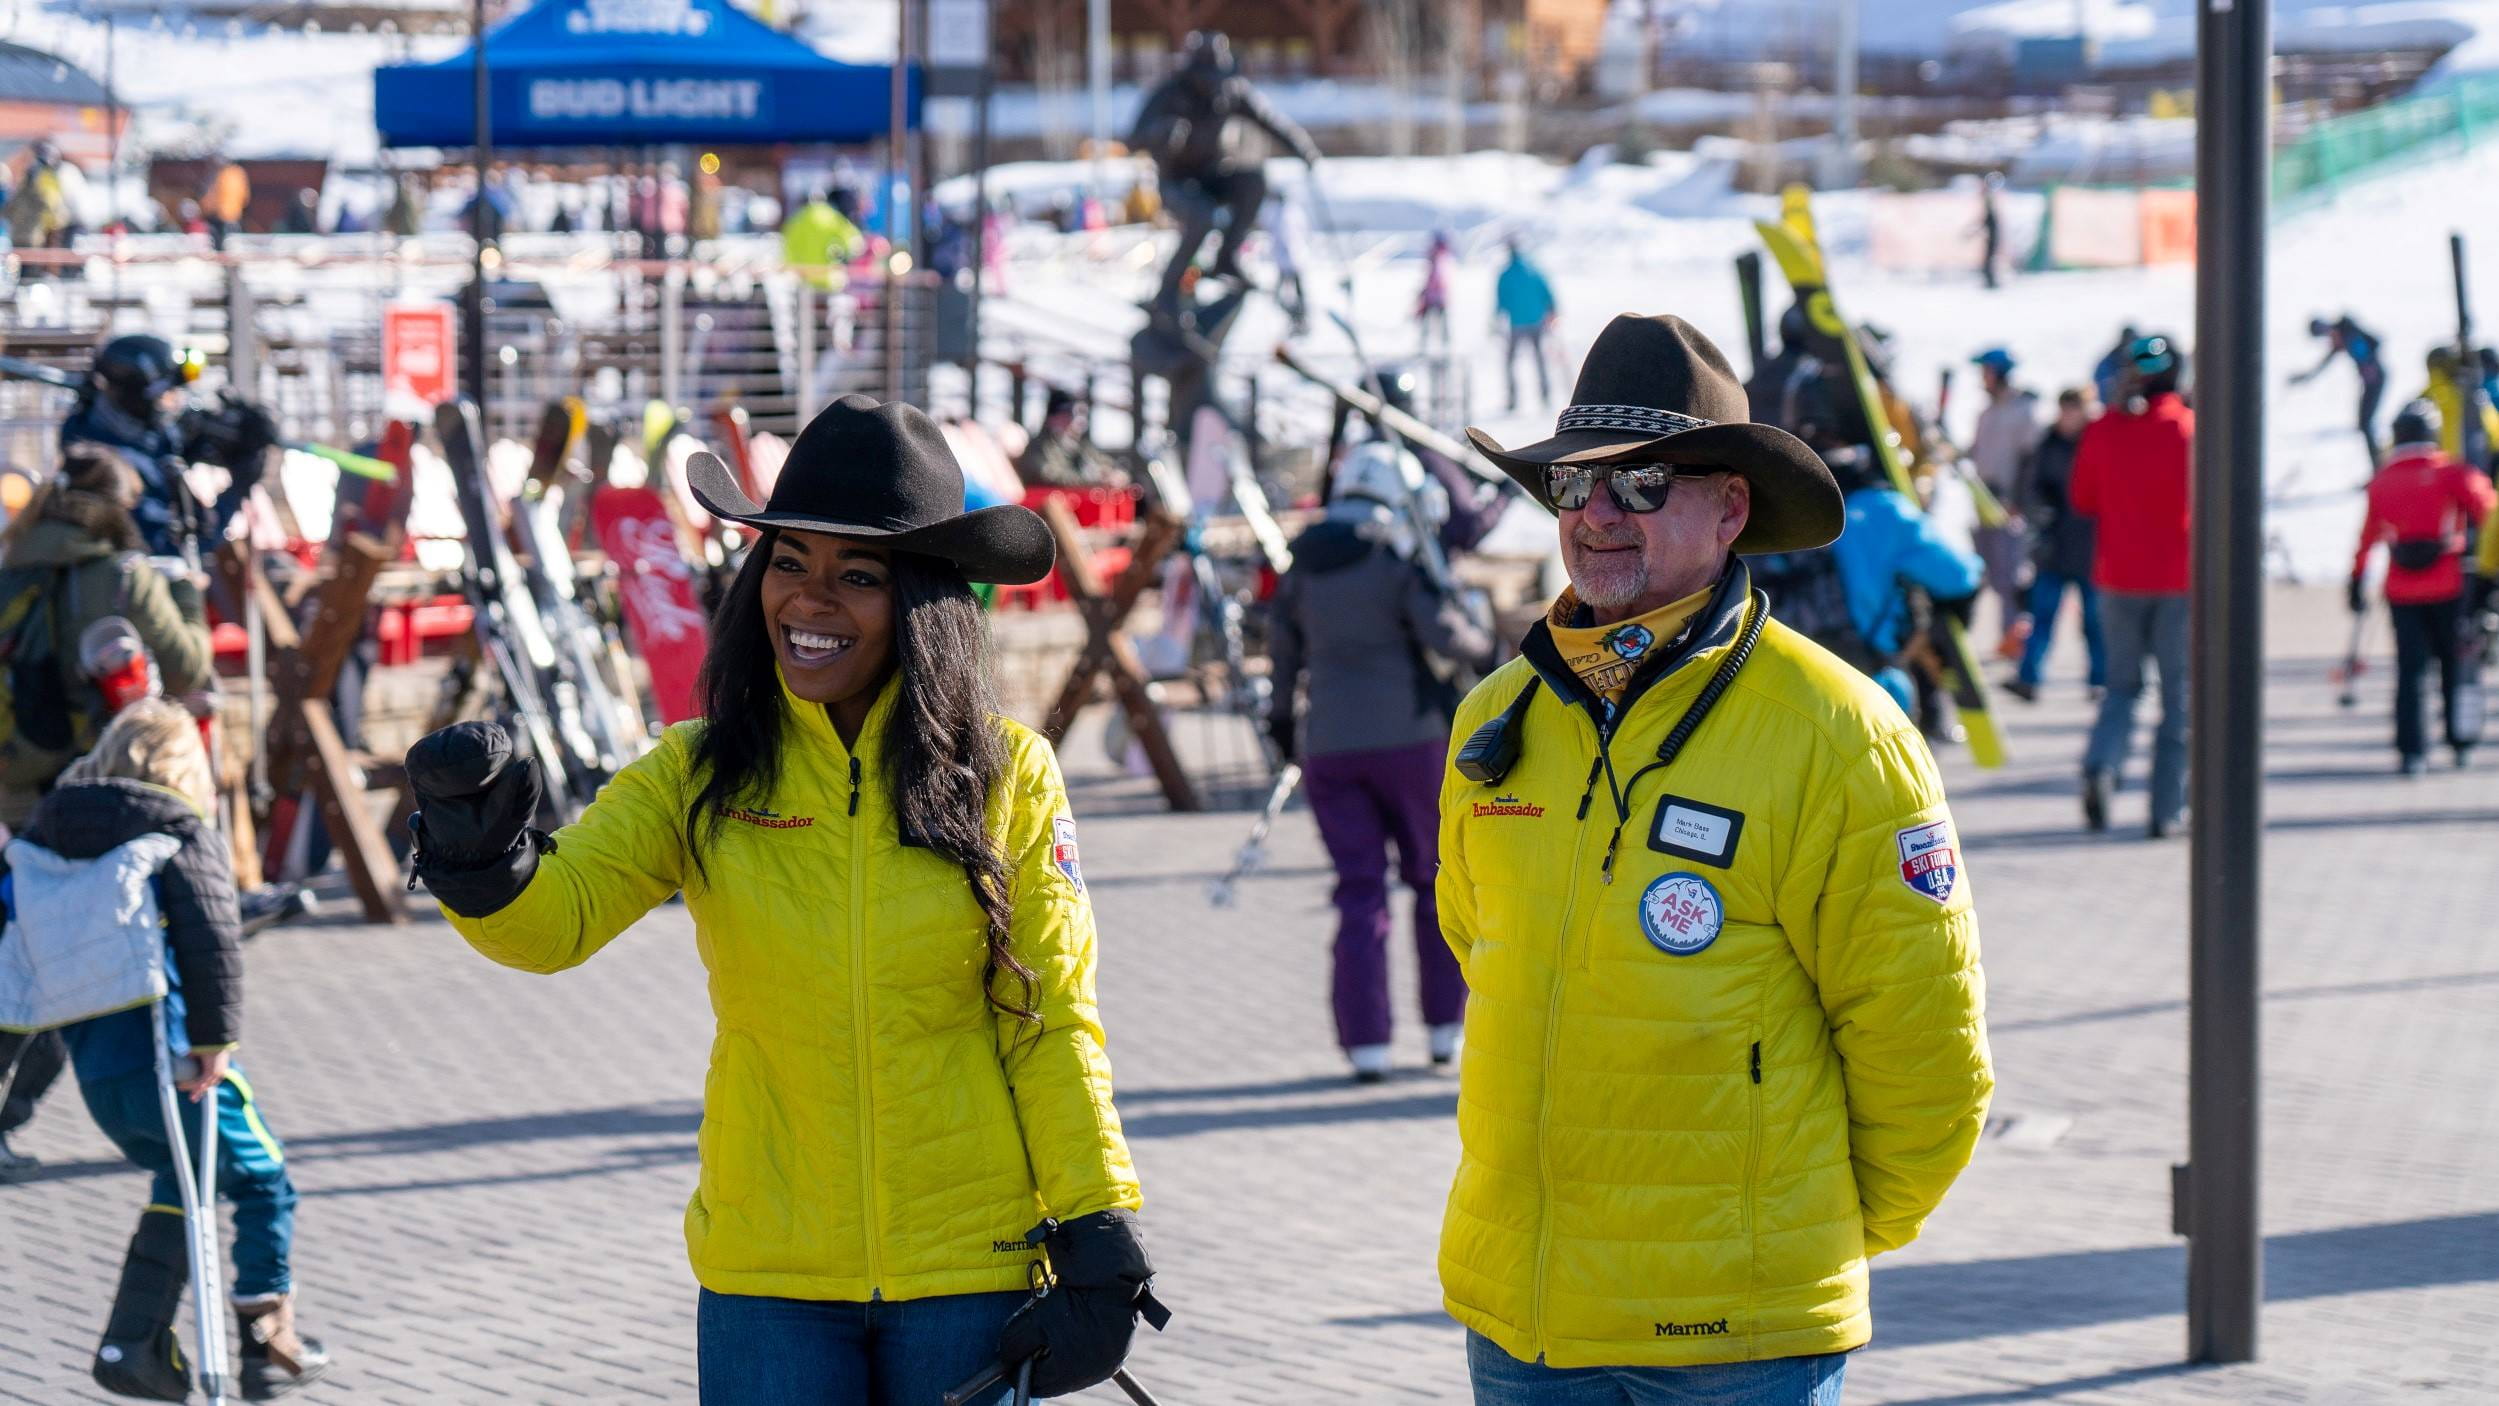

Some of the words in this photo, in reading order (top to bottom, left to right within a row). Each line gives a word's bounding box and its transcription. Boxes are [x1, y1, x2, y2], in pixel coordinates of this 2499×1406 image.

[530, 78, 625, 119] BUD
[630, 78, 760, 119] LIGHT
[1472, 801, 1545, 817] Ambassador
[1911, 855, 1929, 875] SKI
[1928, 848, 1951, 870] TOWN
[1660, 908, 1693, 935] ME
[1661, 892, 1708, 925] ASK
[992, 1240, 1039, 1253] Marm
[1654, 1317, 1729, 1337] Marmot
